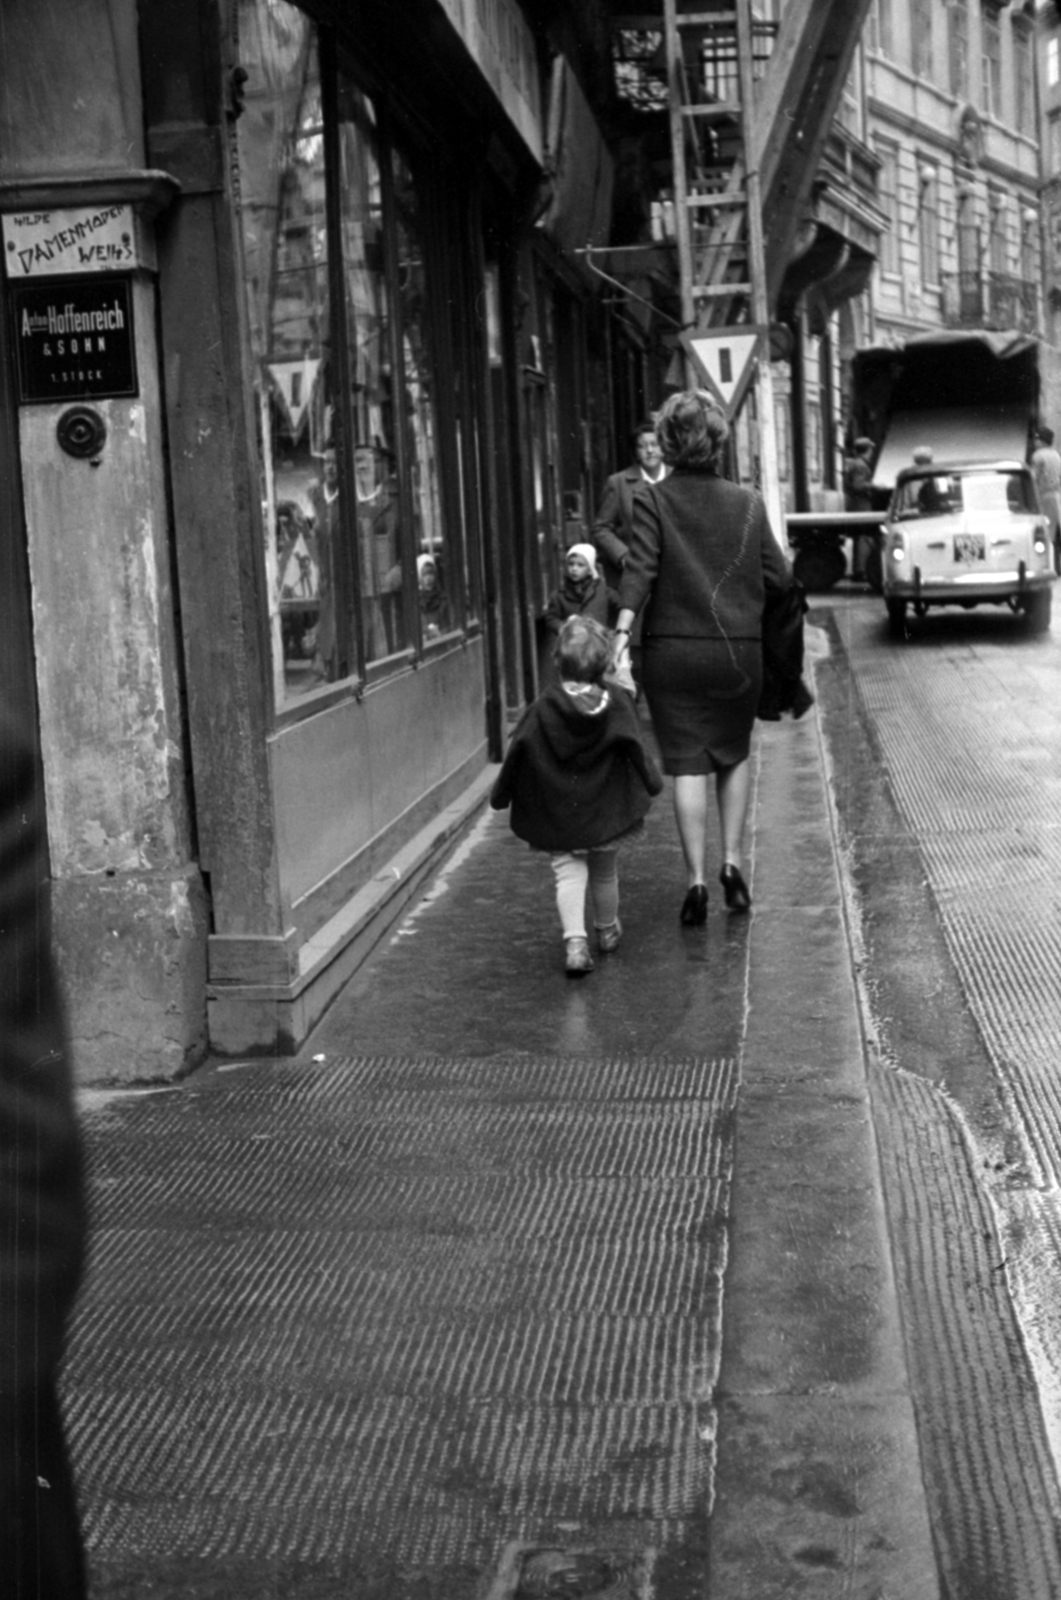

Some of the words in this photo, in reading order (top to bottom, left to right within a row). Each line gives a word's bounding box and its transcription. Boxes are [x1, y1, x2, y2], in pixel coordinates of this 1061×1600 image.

[48, 300, 124, 337] Hoffenreich
[43, 343, 52, 356] &
[57, 336, 106, 355] SOHN
[62, 370, 102, 382] STOCK
